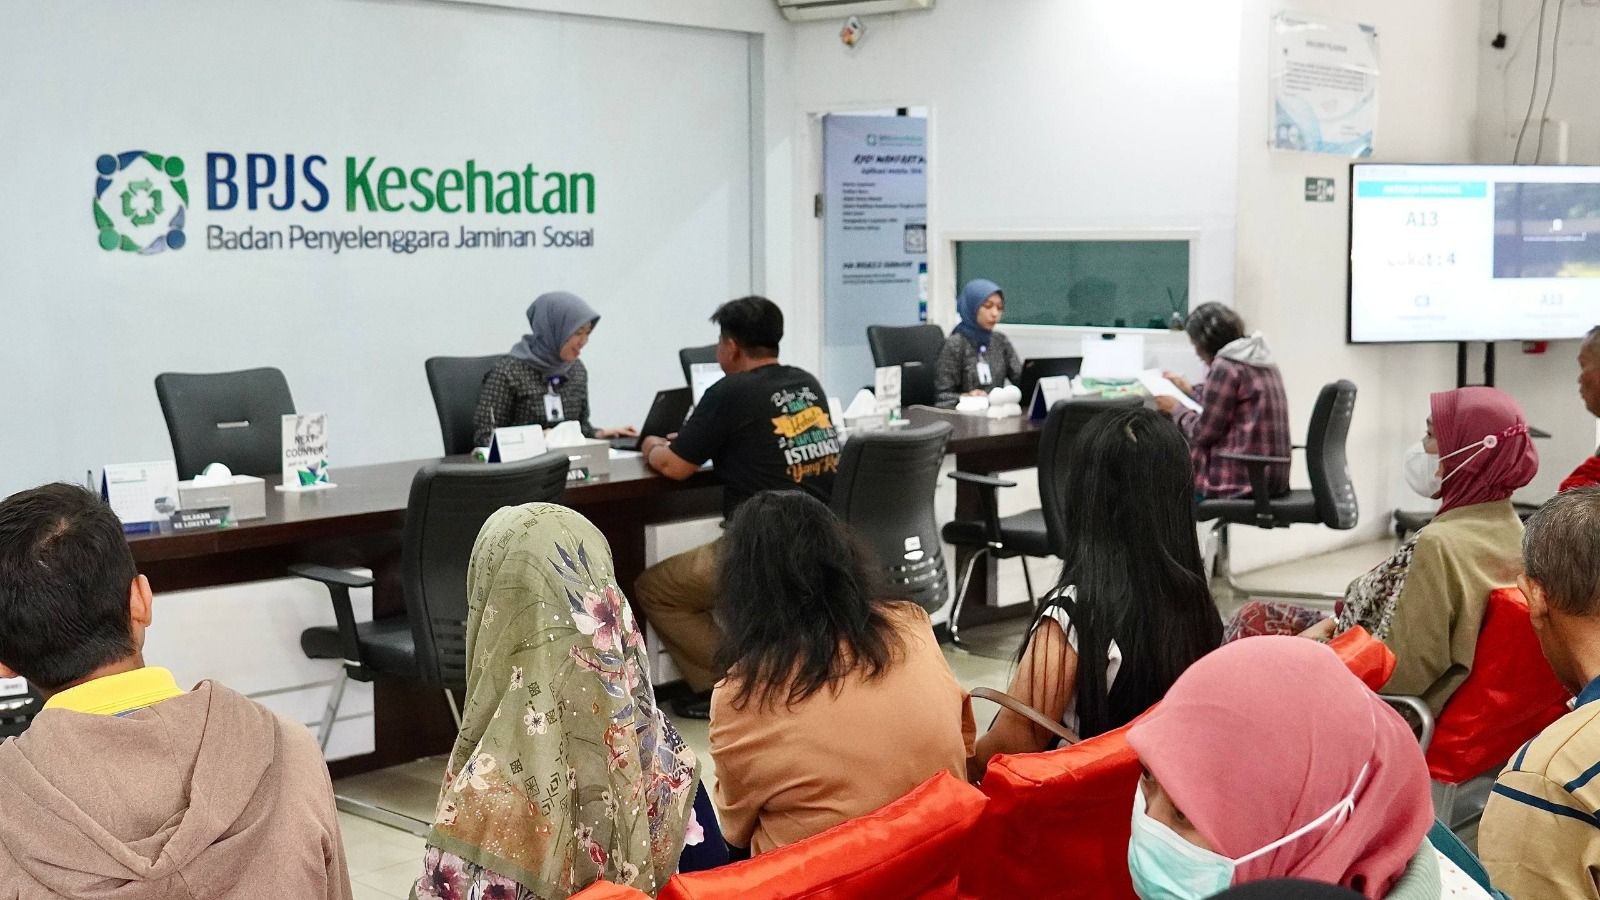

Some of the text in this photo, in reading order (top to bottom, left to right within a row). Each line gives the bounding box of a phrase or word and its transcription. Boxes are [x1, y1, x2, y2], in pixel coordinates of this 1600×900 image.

[206, 152, 596, 215] BPJS Kesehatan
[1405, 211, 1439, 227] A13
[206, 224, 595, 254] Badan Penyelenggara Jaminan Sosial
[295, 433, 315, 445] NEXT
[286, 445, 324, 458] COUNTER
[183, 520, 205, 529] LOKET
